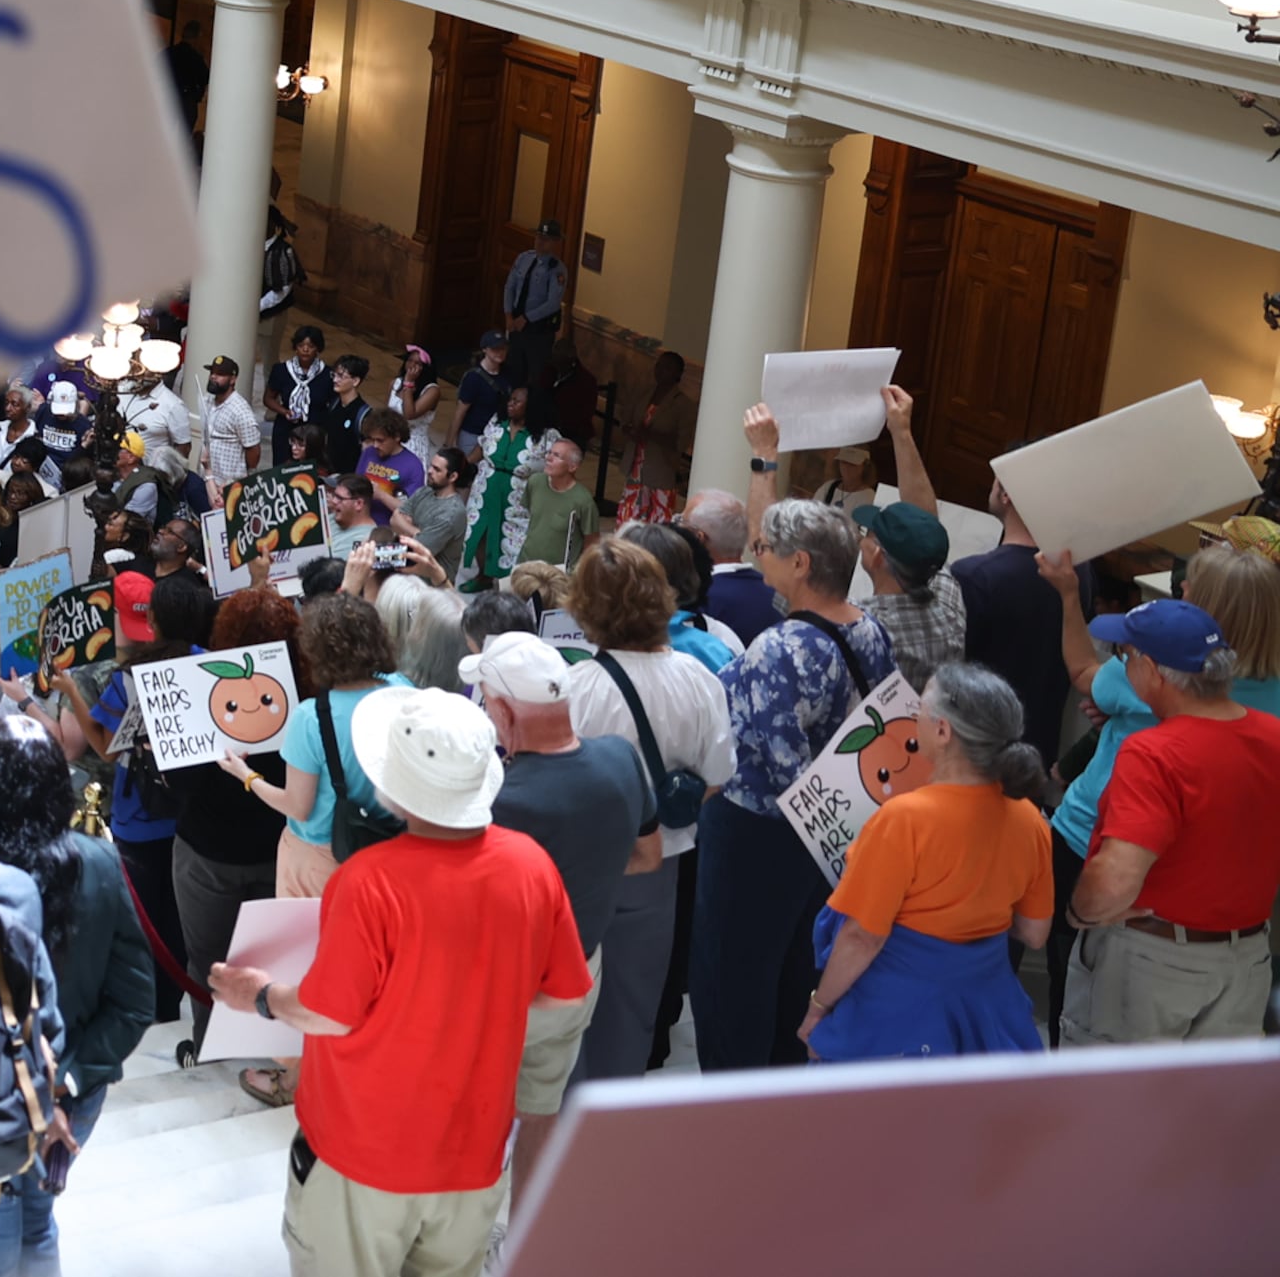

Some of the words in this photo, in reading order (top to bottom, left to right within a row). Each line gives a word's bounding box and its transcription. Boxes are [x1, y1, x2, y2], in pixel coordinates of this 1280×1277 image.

[237, 488, 308, 556] GEORGIA
[5, 569, 61, 605] POWER
[14, 597, 32, 617] TO
[7, 612, 40, 635] PEO
[141, 667, 179, 693] FAIR
[146, 689, 191, 715] MAPS
[154, 715, 185, 739] ARE
[159, 730, 217, 761] PEACHY
[789, 774, 830, 819] FAIR
[804, 789, 852, 840] MAPS
[819, 825, 855, 862] ARE
